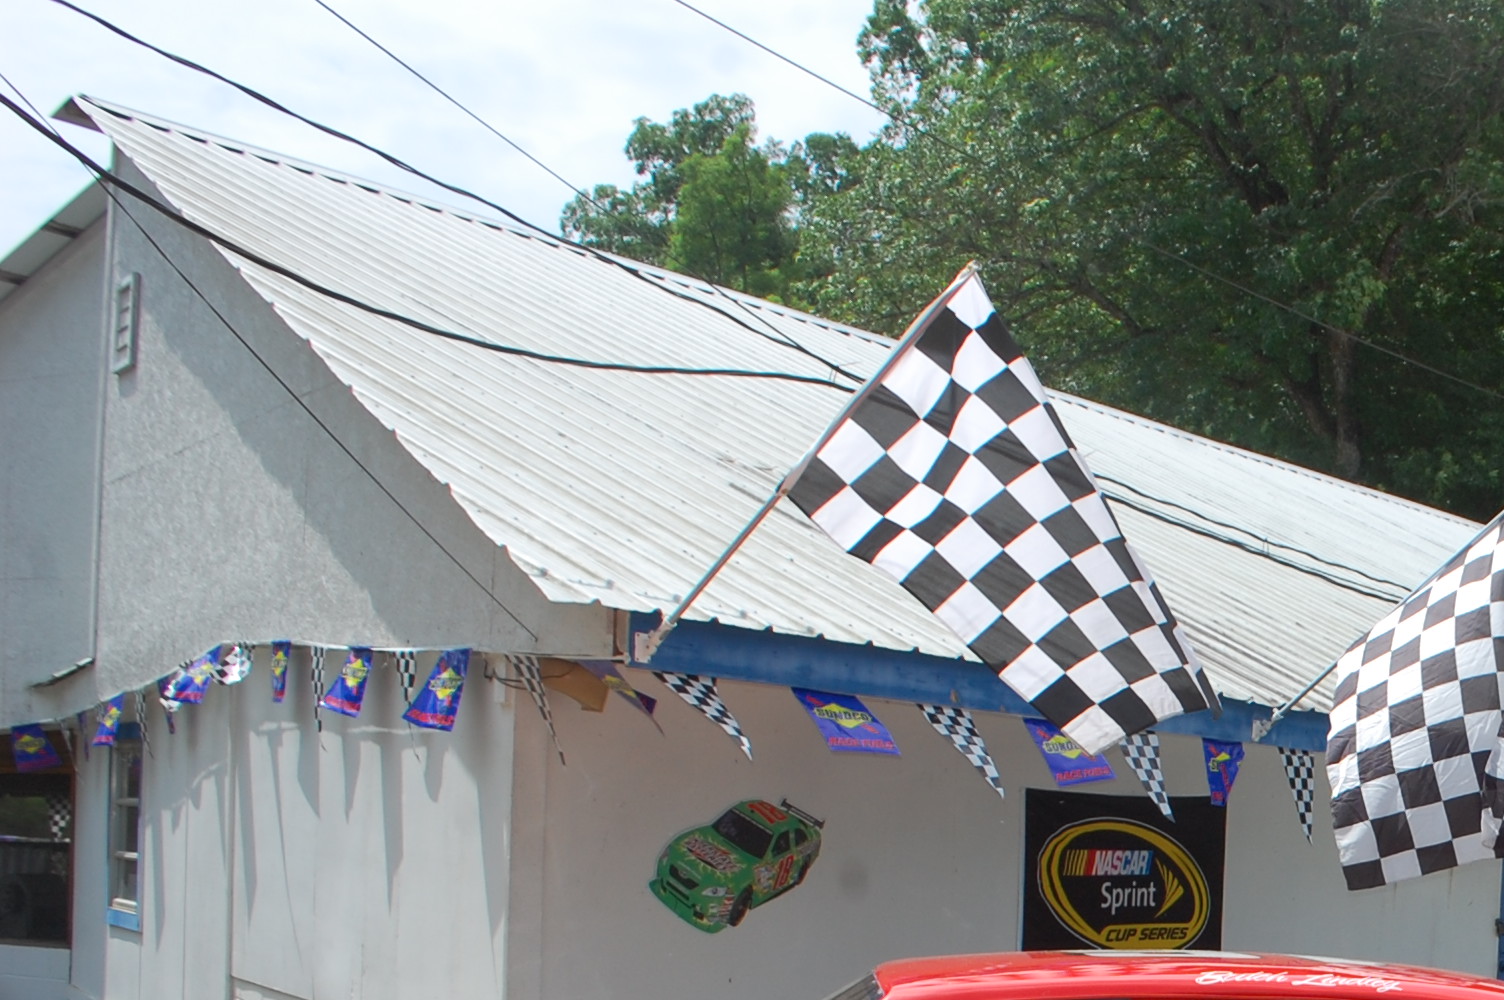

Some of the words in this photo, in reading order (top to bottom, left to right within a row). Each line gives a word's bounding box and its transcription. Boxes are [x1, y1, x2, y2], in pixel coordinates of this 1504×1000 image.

[815, 706, 870, 722] SUNOCO
[1092, 850, 1150, 876] NASCAR
[1101, 881, 1156, 915] Sprint
[1105, 928, 1138, 942] CUP
[1138, 927, 1189, 941] SERIES
[1195, 970, 1288, 985] Butch
